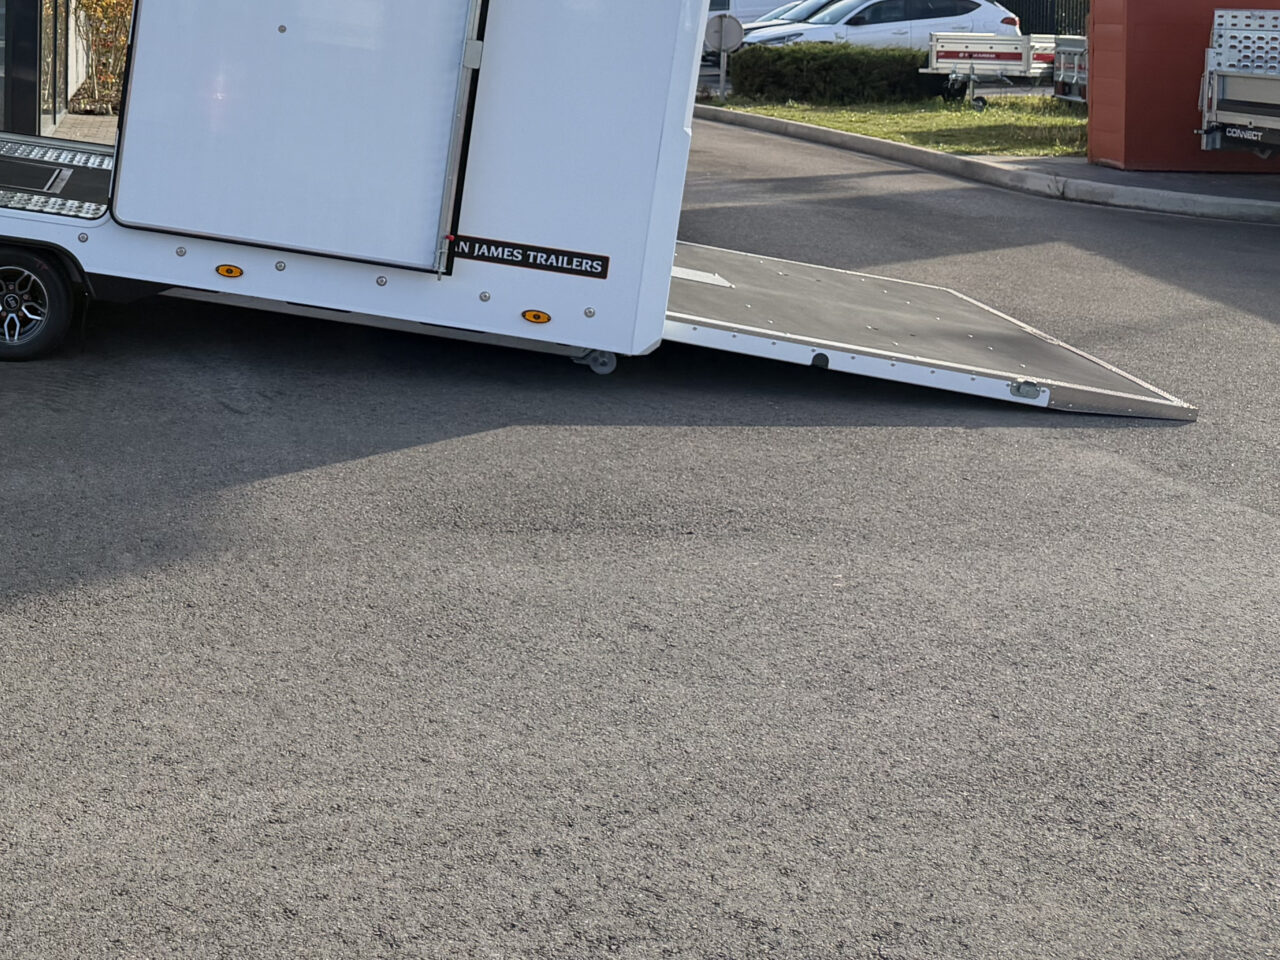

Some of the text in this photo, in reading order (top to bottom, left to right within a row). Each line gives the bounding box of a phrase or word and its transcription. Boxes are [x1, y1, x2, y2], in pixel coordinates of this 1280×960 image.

[1226, 127, 1263, 141] CONNECT
[473, 243, 522, 261] JAMES
[527, 251, 603, 273] TRAILERS
